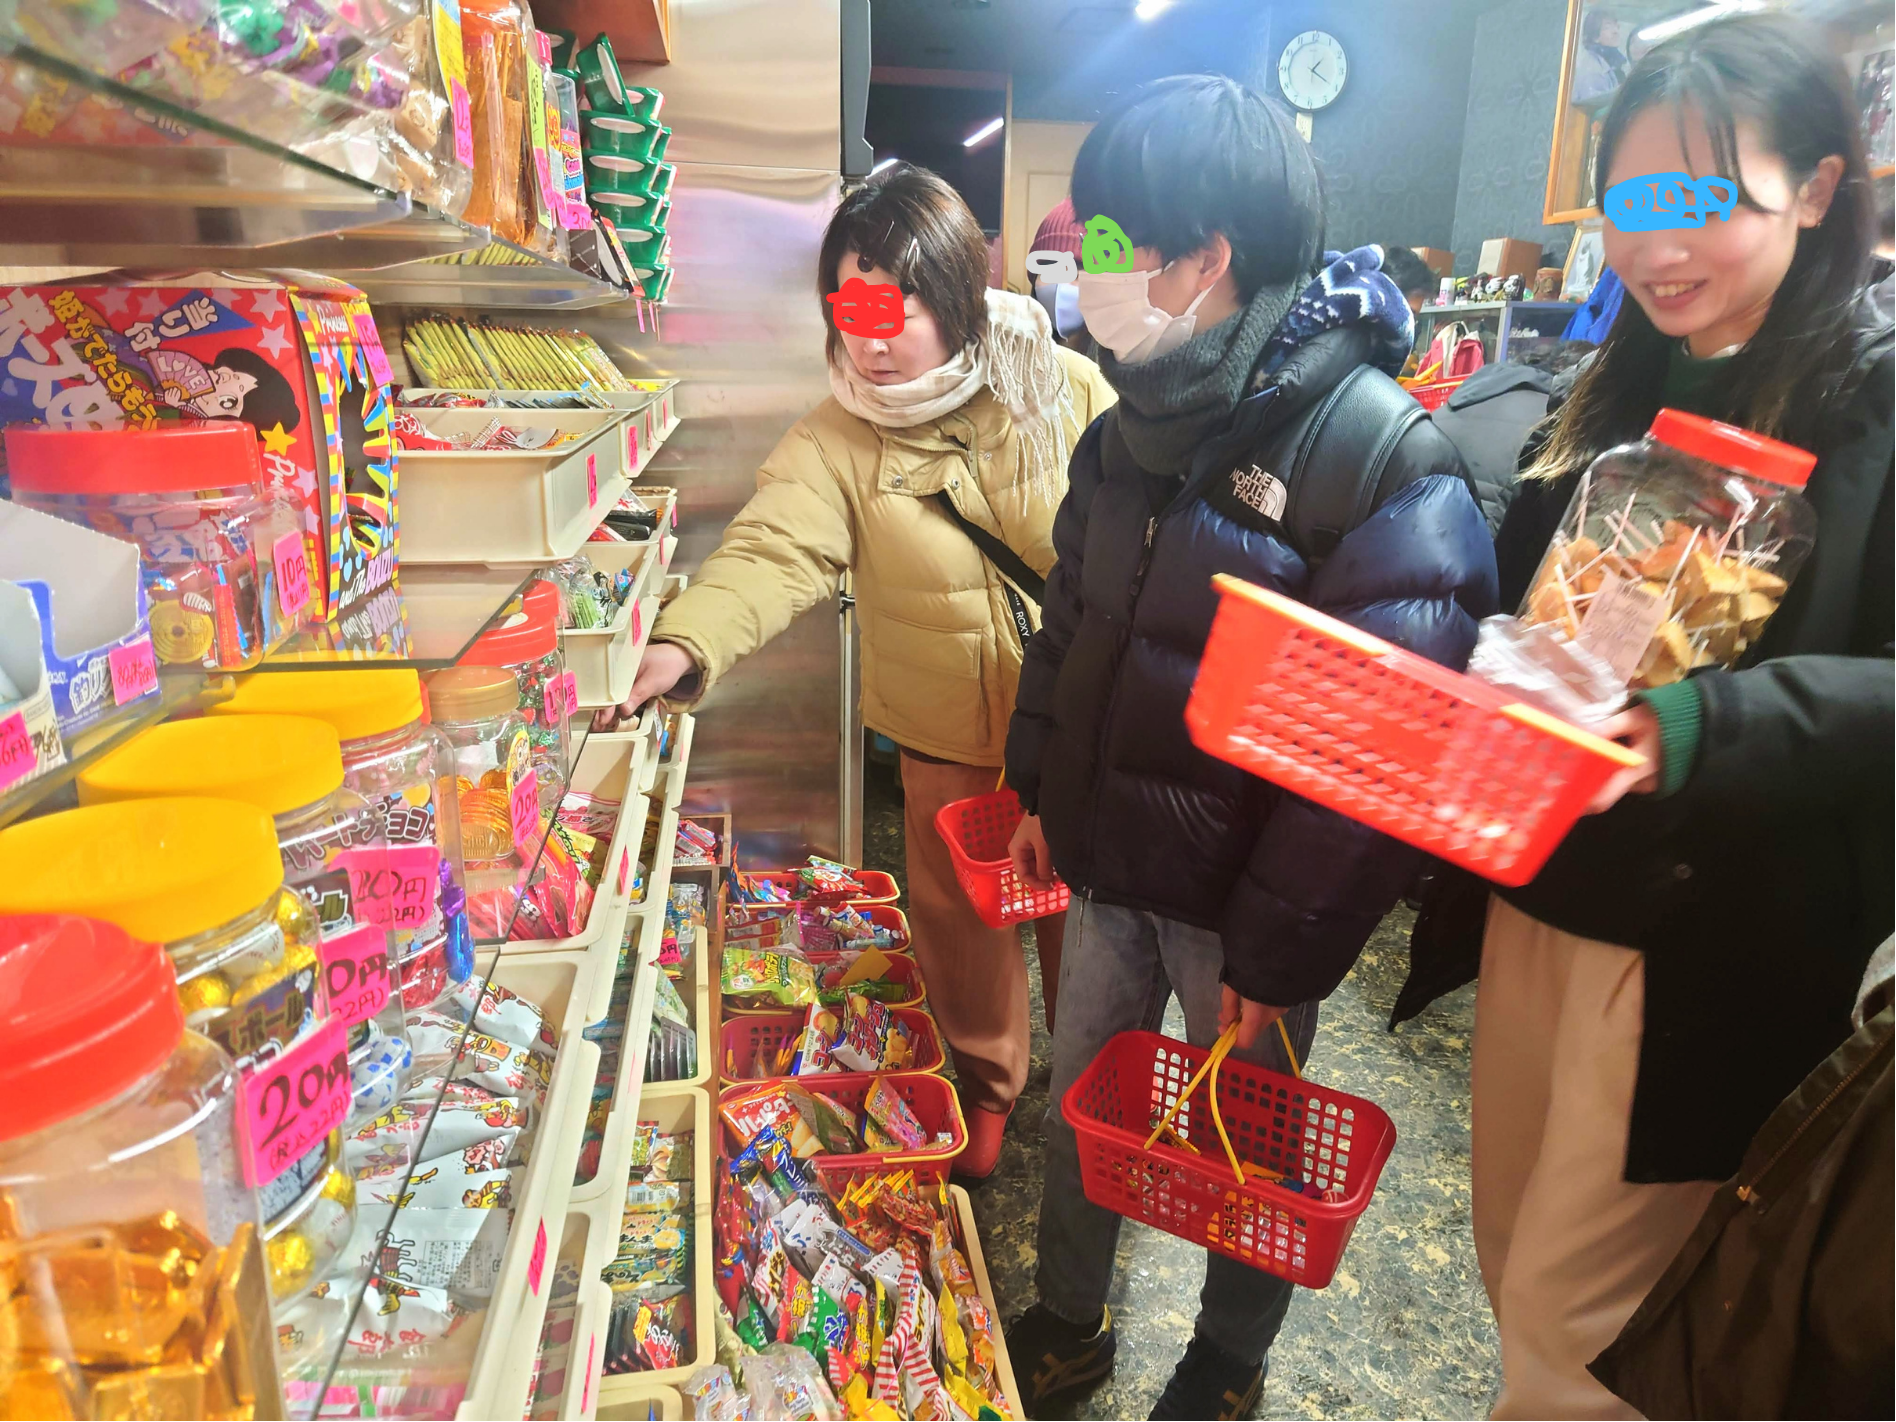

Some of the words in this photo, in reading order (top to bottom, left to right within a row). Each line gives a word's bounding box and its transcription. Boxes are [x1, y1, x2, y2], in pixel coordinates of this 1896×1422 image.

[125, 297, 217, 351] 当り付
[1229, 467, 1268, 501] NORTH
[1233, 484, 1261, 510] FACE
[1250, 463, 1274, 488] THE
[364, 547, 393, 595] BOUZU
[1015, 610, 1030, 637] ROXY
[284, 801, 431, 869] ハートチョコ
[327, 953, 388, 999] 0円
[850, 1012, 866, 1055] コーン
[260, 1051, 349, 1149] 20円
